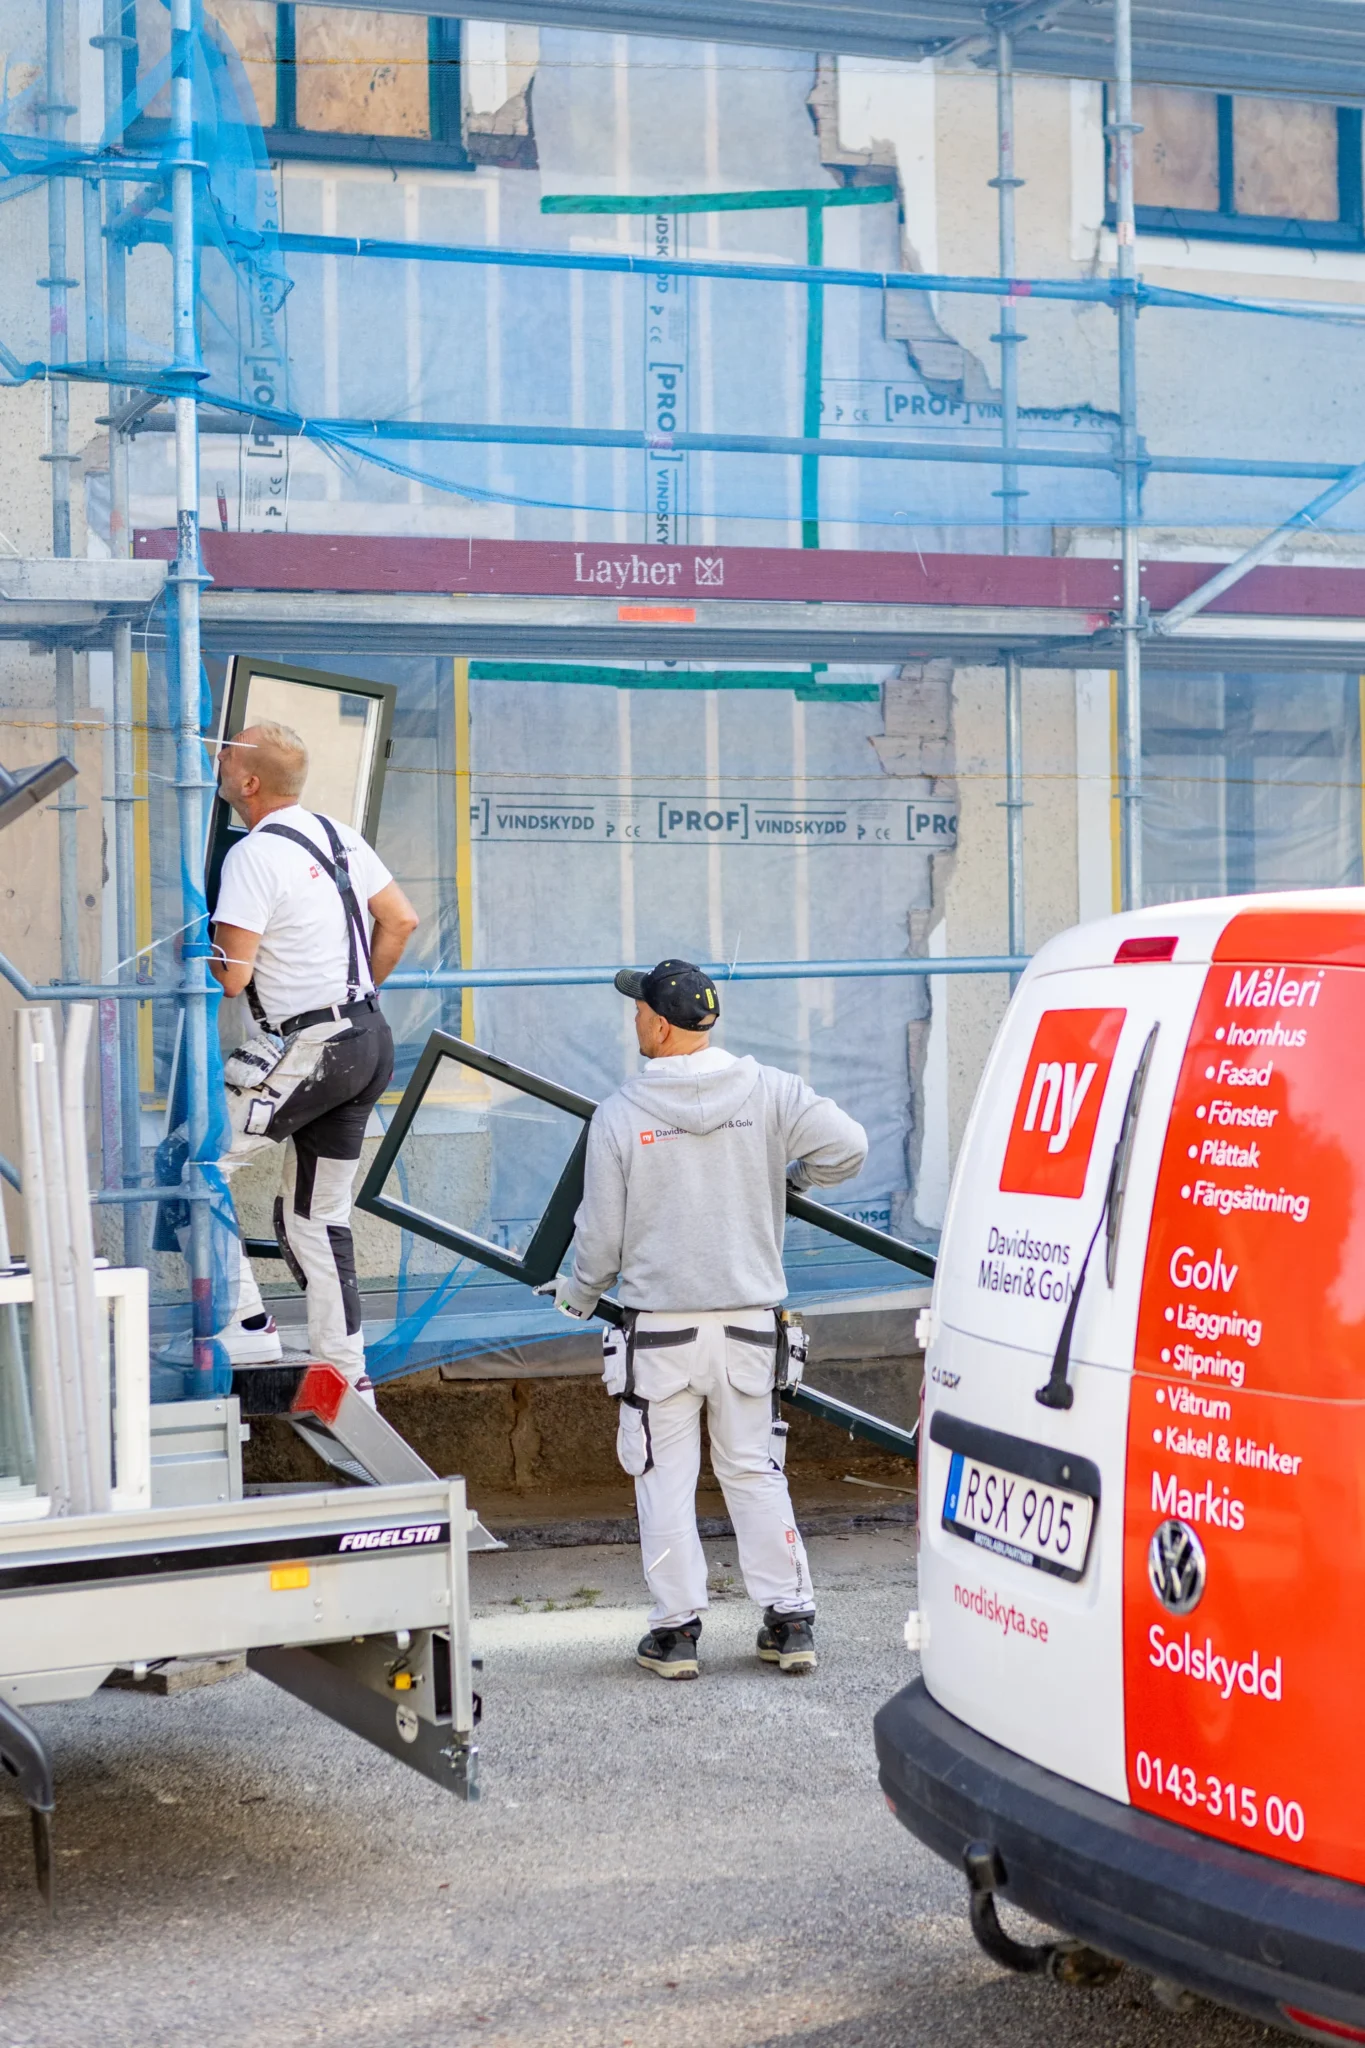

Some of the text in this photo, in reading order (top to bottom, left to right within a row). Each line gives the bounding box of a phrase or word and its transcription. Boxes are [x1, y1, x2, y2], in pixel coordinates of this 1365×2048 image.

[574, 552, 682, 590] Layher
[496, 814, 595, 831] VINDSKYDD
[755, 819, 847, 835] VINDSKYDD
[1225, 967, 1325, 1008] Måleri
[1226, 1021, 1307, 1048] Inomhus
[1216, 1059, 1273, 1087] Fasad
[736, 1119, 753, 1128] Golv
[1023, 1061, 1098, 1154] ny
[1207, 1100, 1279, 1128] Fönster
[1200, 1140, 1260, 1169] Plåttak
[1193, 1179, 1310, 1222] Färgsättning
[987, 1226, 1070, 1265] Davidssons
[978, 1259, 1024, 1296] Måleri
[1023, 1266, 1036, 1301] &
[1169, 1246, 1239, 1293] Golv
[1176, 1303, 1262, 1347] Läggning
[1172, 1344, 1245, 1388] Slipning
[1167, 1386, 1231, 1421] Våtrum
[1165, 1426, 1303, 1476] Kakel & klinker
[964, 1467, 1074, 1554] RSX 905
[1151, 1471, 1245, 1531] Markis
[338, 1524, 441, 1552] FOGELSTA
[954, 1584, 1048, 1643] nordiskyta.se
[1149, 1624, 1282, 1701] Solskydd
[1136, 1751, 1305, 1842] 0143-315 00
